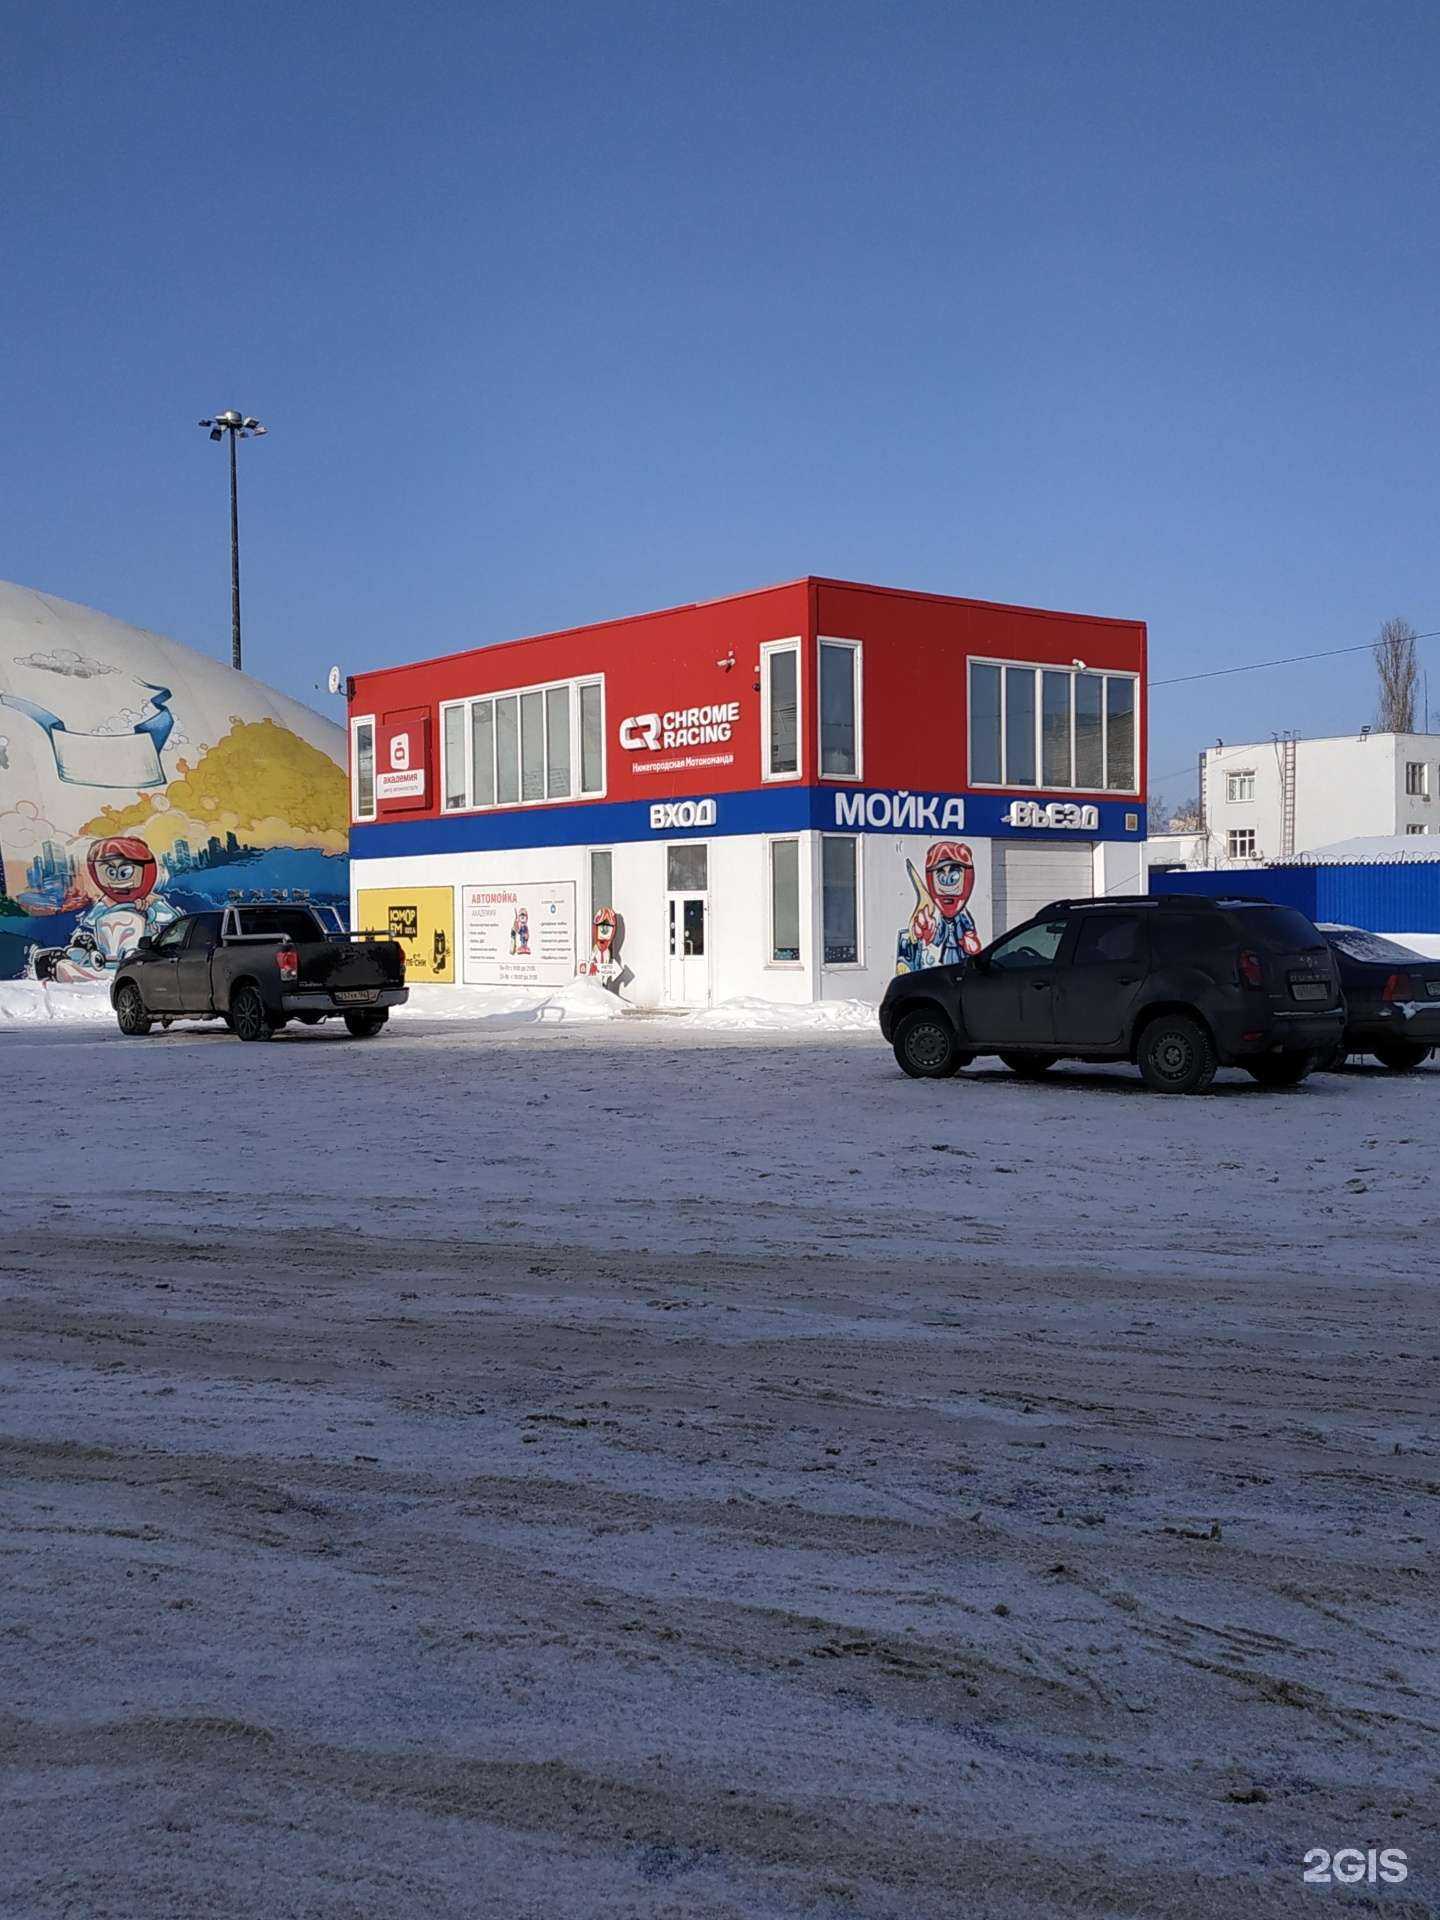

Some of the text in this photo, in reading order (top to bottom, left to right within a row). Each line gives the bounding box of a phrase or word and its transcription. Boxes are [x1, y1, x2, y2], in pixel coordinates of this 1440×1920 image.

[662, 702, 740, 730] CHROME
[663, 723, 732, 749] RACING
[632, 754, 734, 773] Нижегородская Мотокоманда
[383, 773, 418, 785] академия
[650, 798, 717, 829] ВХОД
[834, 790, 965, 830] МОЙКА
[1009, 800, 1099, 830] ВЪЕЗД
[471, 890, 518, 904] АВТОМОЙКА
[390, 910, 416, 926] ЮМОР
